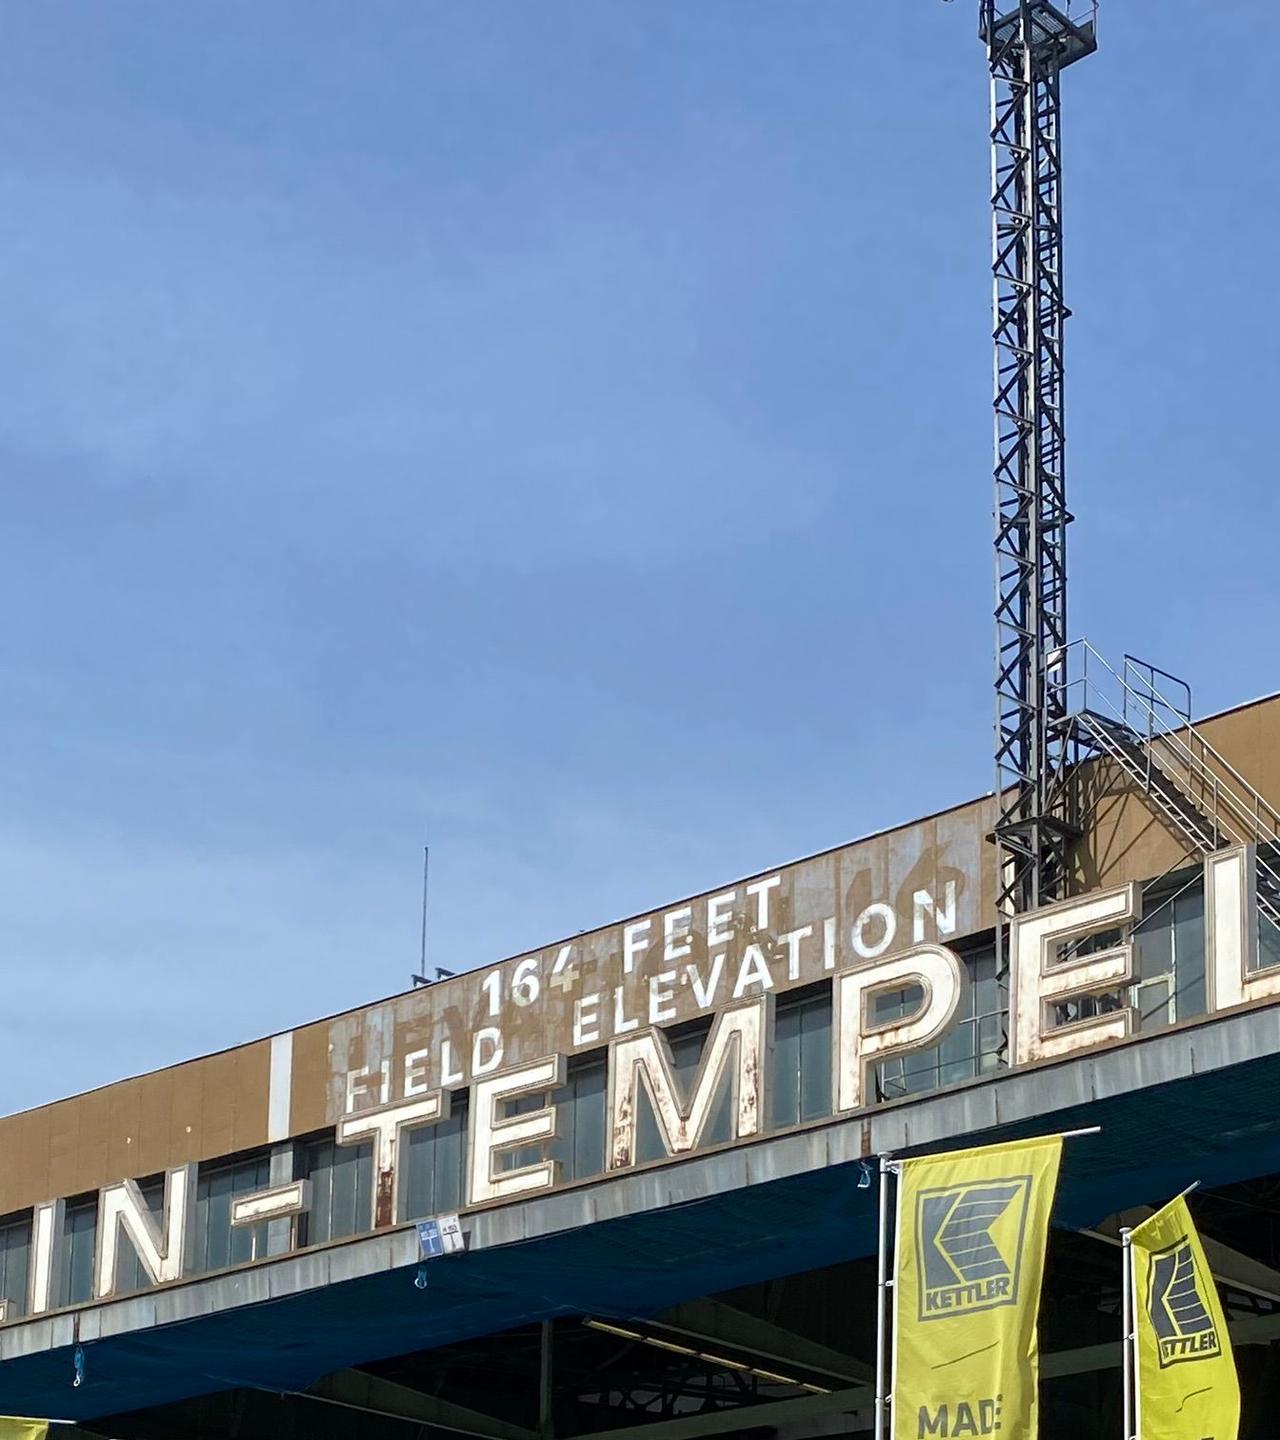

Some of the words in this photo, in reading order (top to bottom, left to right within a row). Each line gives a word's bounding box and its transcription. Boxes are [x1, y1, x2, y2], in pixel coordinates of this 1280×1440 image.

[482, 946, 580, 1016] 164
[623, 875, 781, 974] FEET
[346, 1027, 504, 1114] FIELD
[573, 880, 956, 1046] ELEVATION
[925, 1277, 1010, 1311] KETTLER
[1161, 1331, 1218, 1359] ETTLER
